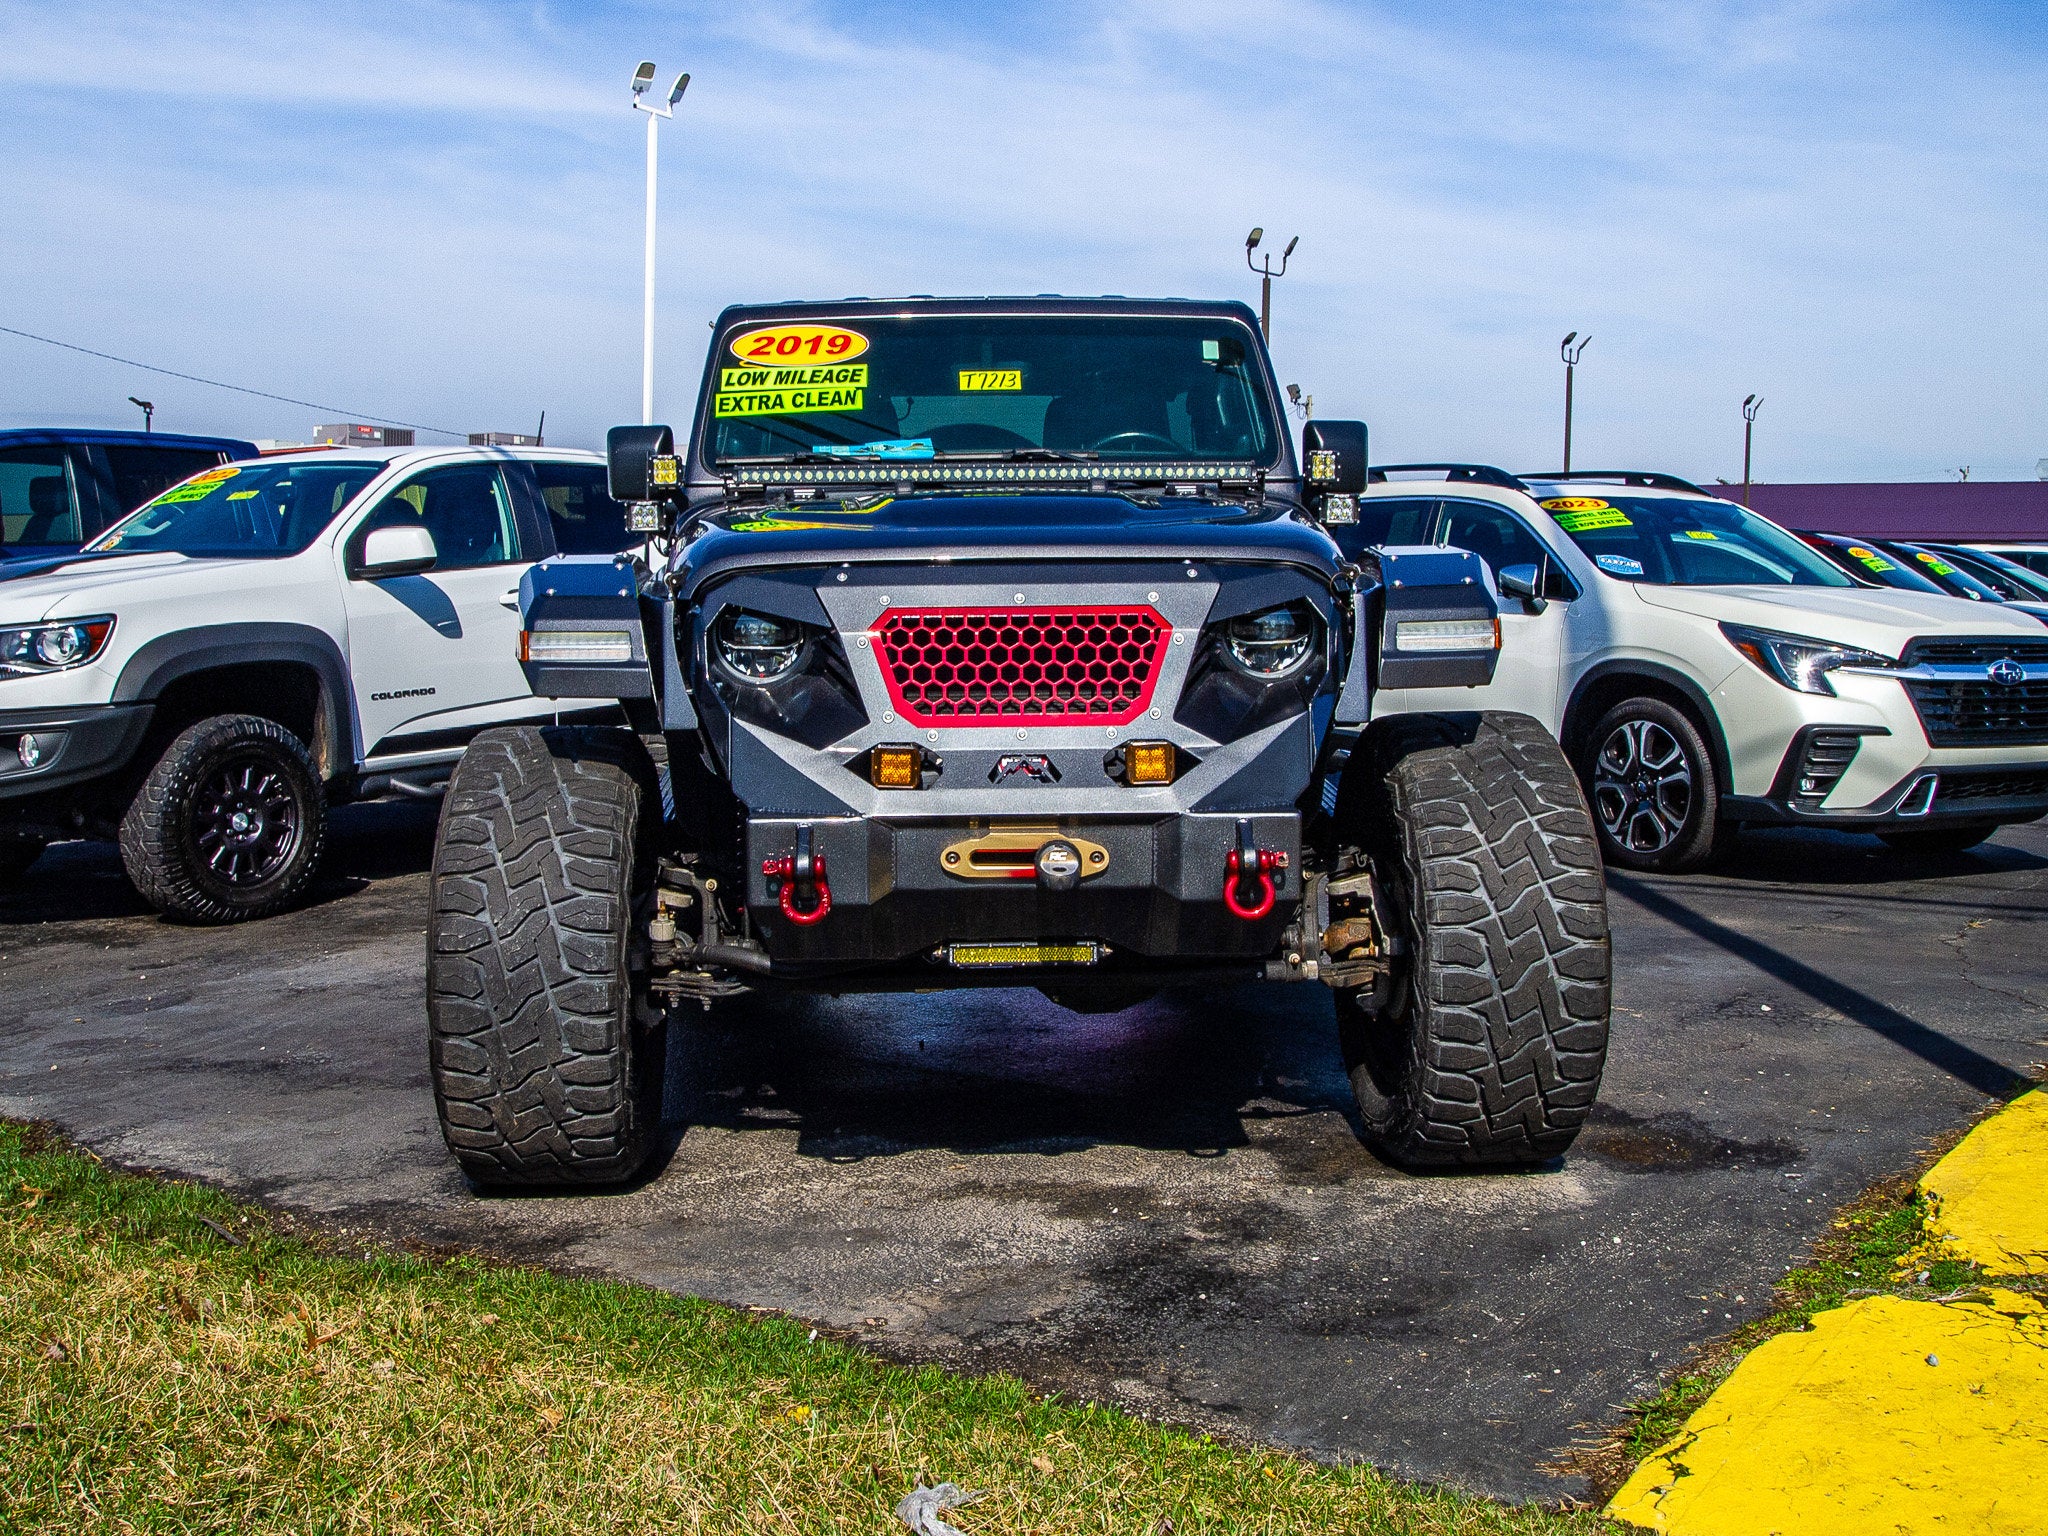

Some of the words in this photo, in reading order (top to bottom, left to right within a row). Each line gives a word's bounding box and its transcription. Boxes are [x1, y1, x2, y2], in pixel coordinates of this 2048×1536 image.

[747, 334, 852, 356] 2019
[724, 371, 770, 387] LOW
[773, 368, 863, 385] MILEAGE
[718, 394, 785, 413] EXTRA
[791, 389, 857, 408] CLEAN
[1549, 499, 1602, 509] 2023
[371, 687, 436, 701] COLORADO
